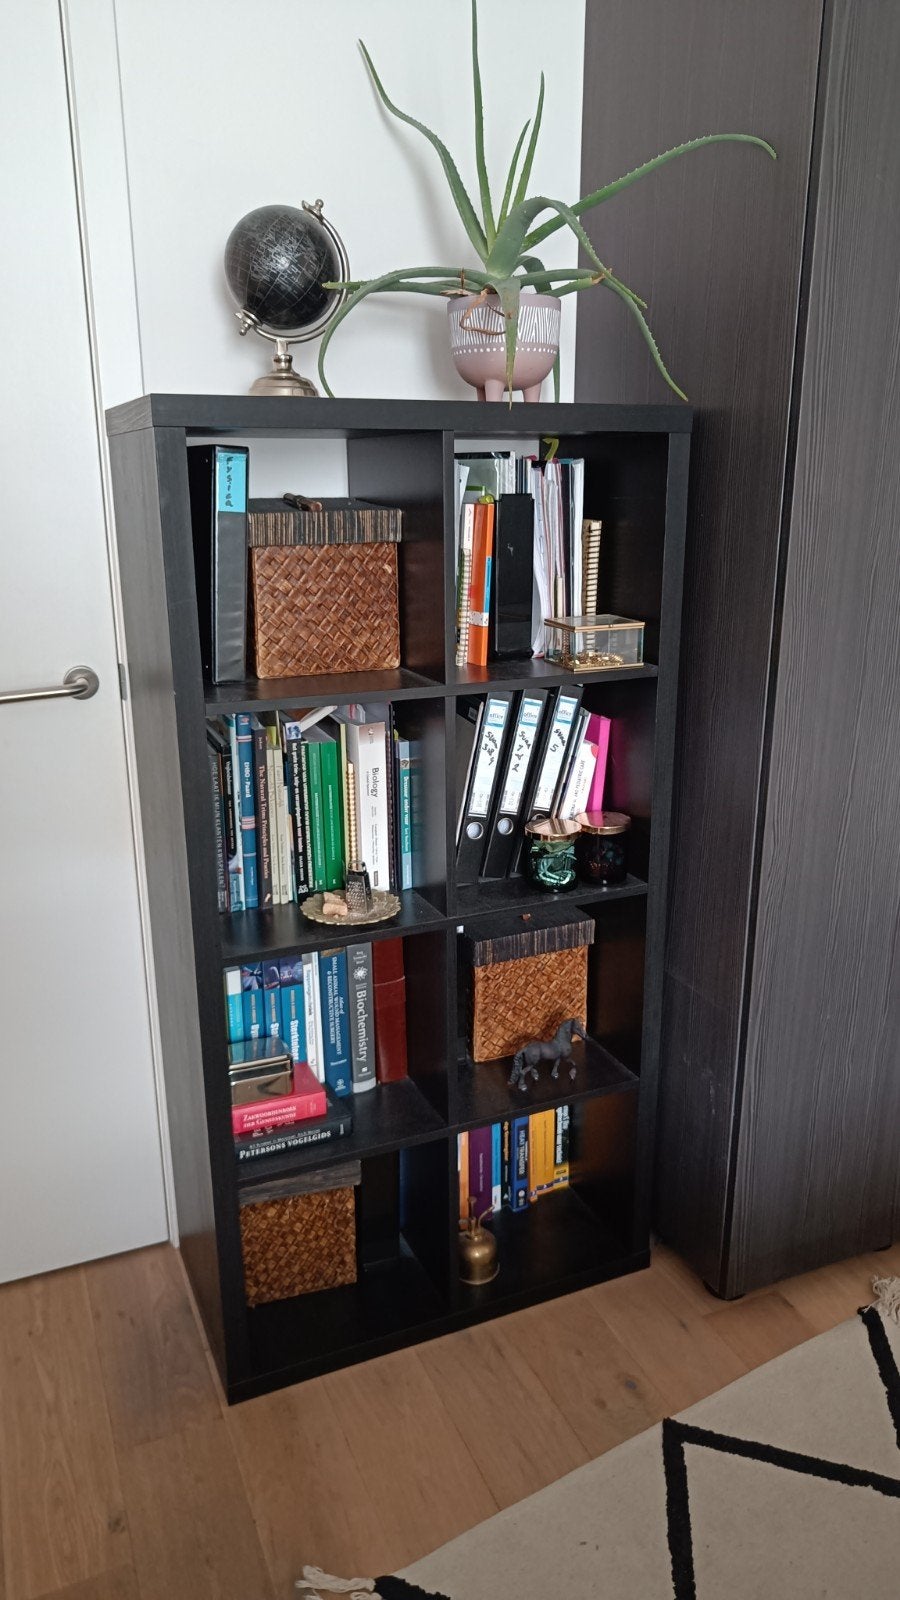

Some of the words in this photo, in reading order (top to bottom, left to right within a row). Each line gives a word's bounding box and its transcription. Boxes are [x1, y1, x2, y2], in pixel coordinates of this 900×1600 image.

[550, 744, 559, 752] 5
[258, 765, 266, 777] The
[370, 767, 380, 797] Biology
[212, 777, 220, 792] LAAT
[259, 777, 267, 802] Natural
[215, 819, 223, 848] KLANTEN
[260, 820, 269, 846] Principles
[356, 990, 368, 1062] Biochemistry
[287, 1130, 331, 1147] VOGELGIDS
